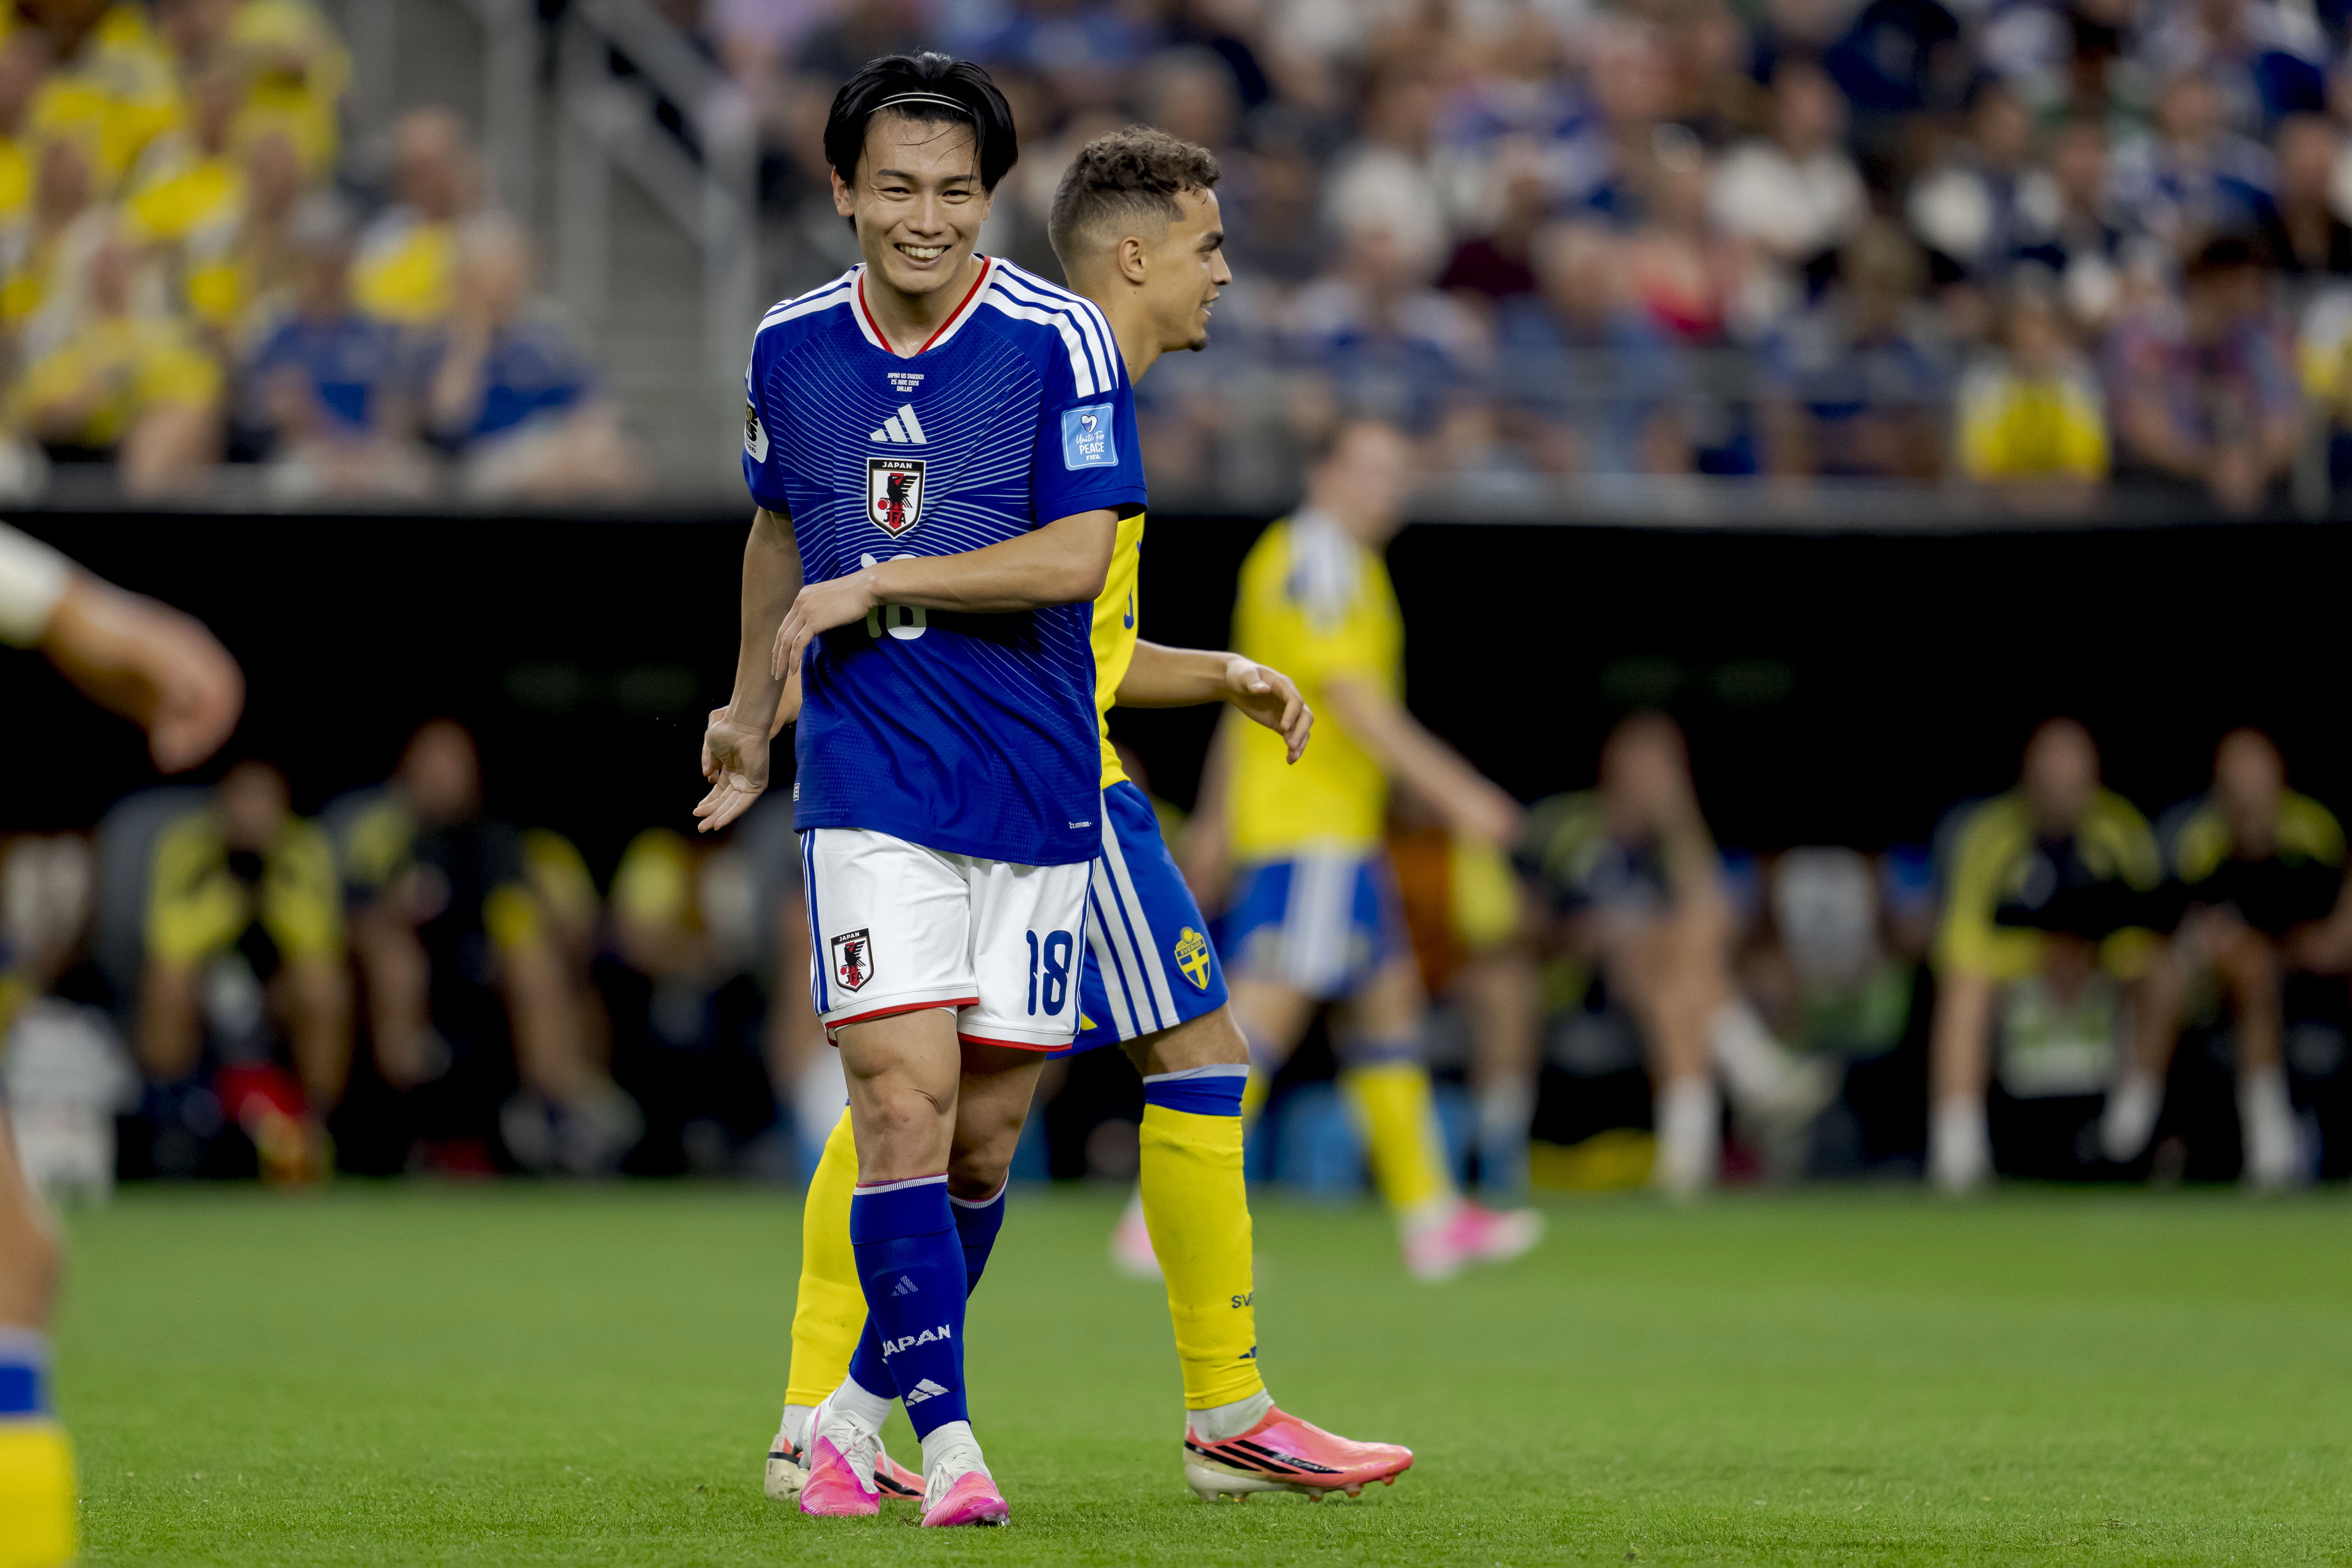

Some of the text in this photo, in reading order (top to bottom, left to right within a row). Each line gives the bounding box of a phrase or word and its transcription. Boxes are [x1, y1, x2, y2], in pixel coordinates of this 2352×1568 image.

[1076, 431, 1105, 445] Unite For
[1079, 442, 1105, 454] PEACE
[883, 511, 906, 524] JFA
[839, 931, 860, 941] JAPAN
[846, 972, 864, 984] JFA
[1026, 929, 1073, 1016] 18
